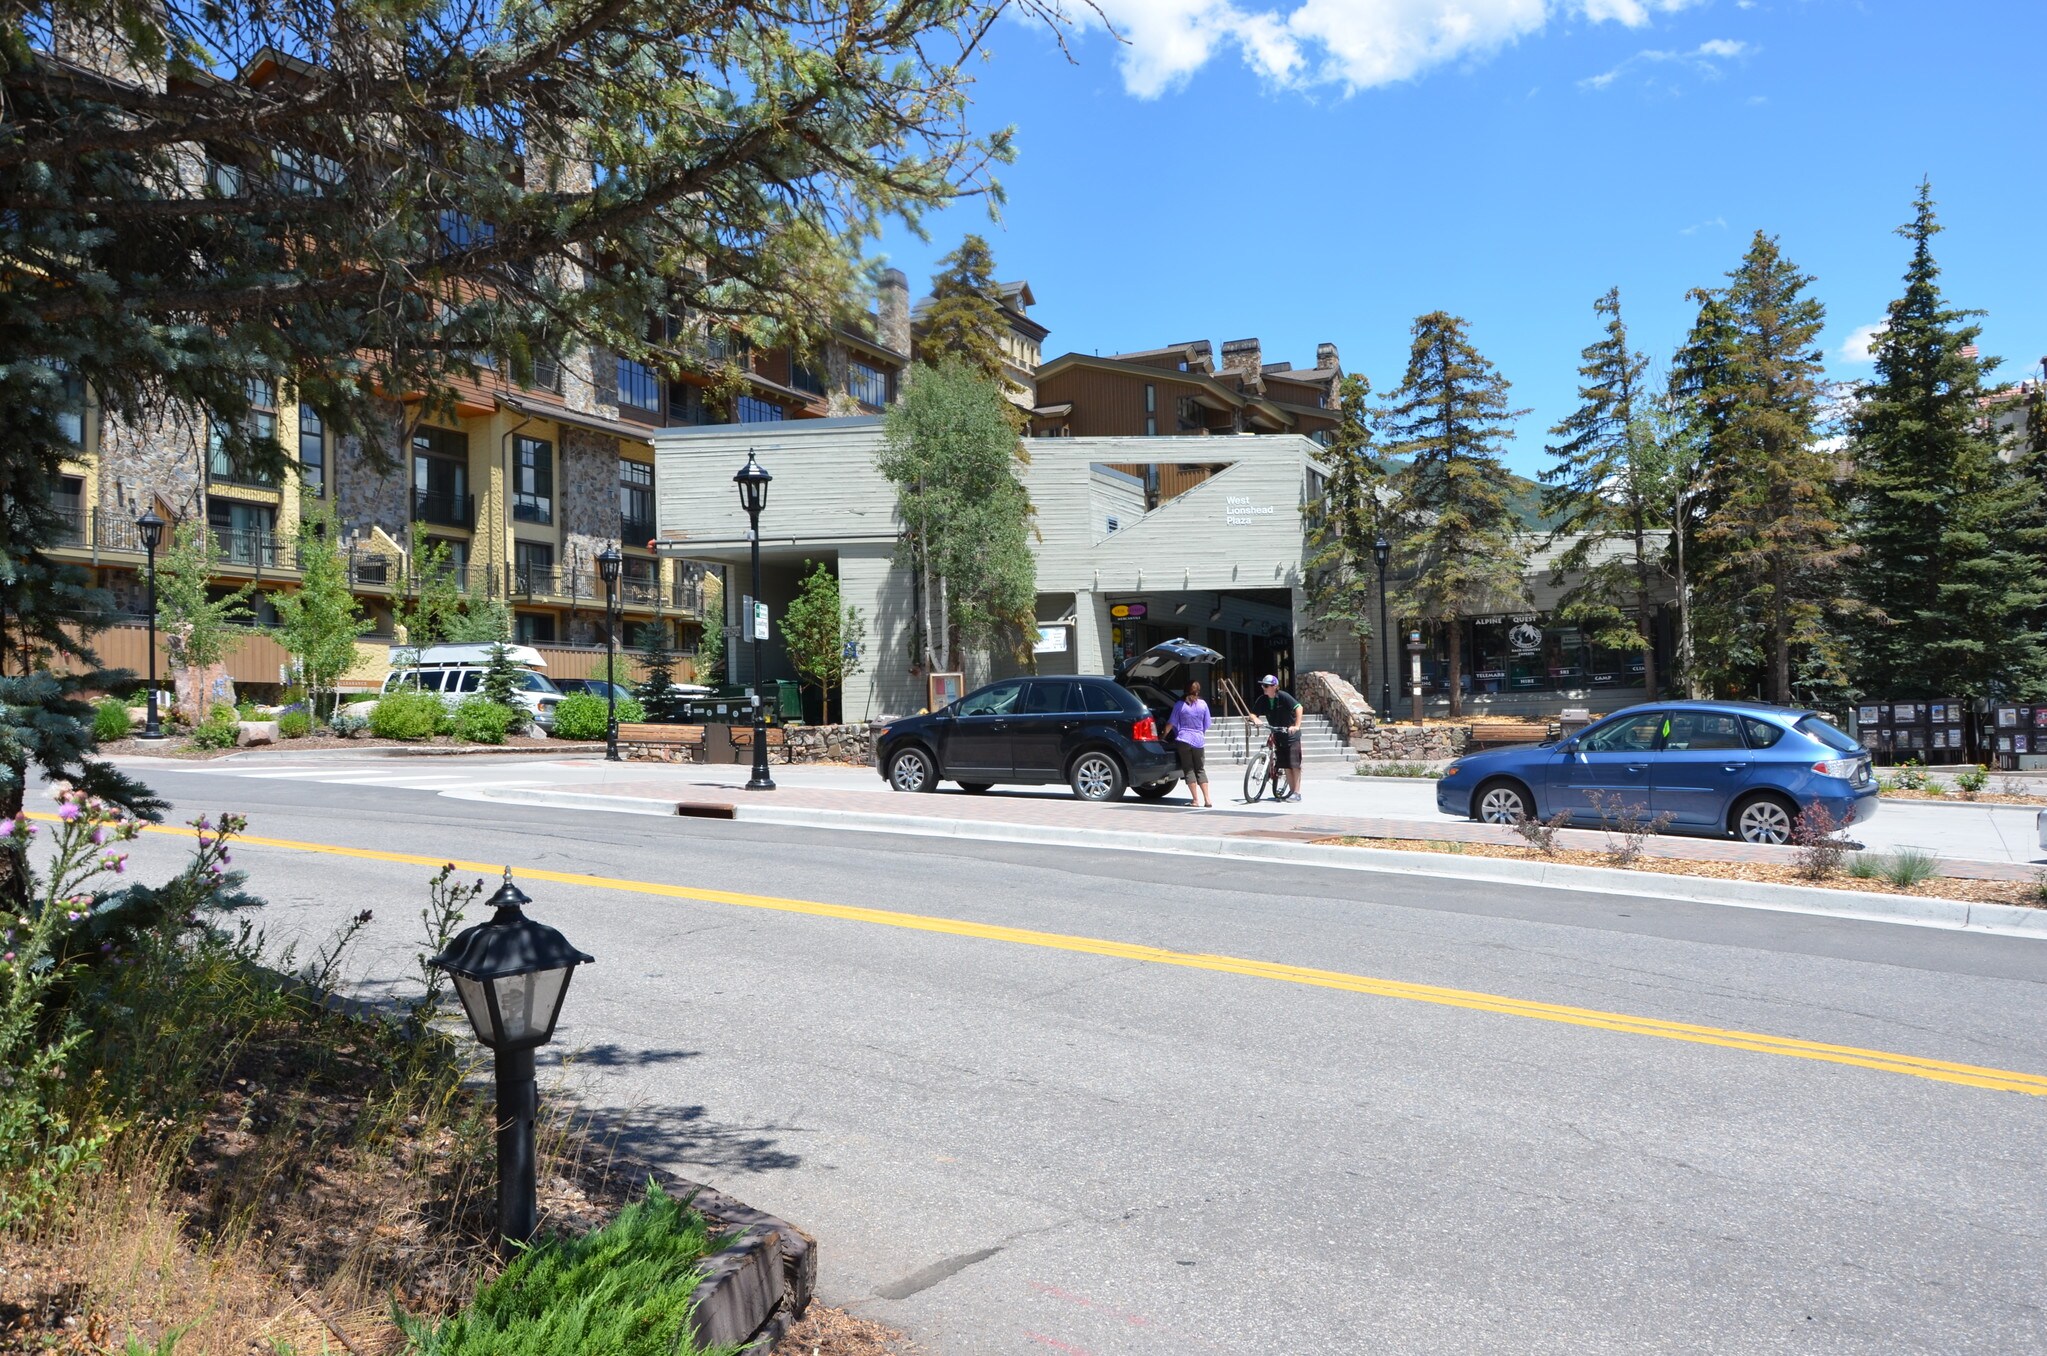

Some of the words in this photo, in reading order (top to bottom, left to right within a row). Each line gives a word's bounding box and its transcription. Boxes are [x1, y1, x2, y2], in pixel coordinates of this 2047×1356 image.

[1226, 496, 1250, 505] West
[1226, 505, 1274, 515] Lionshead
[1226, 516, 1252, 526] Plaza
